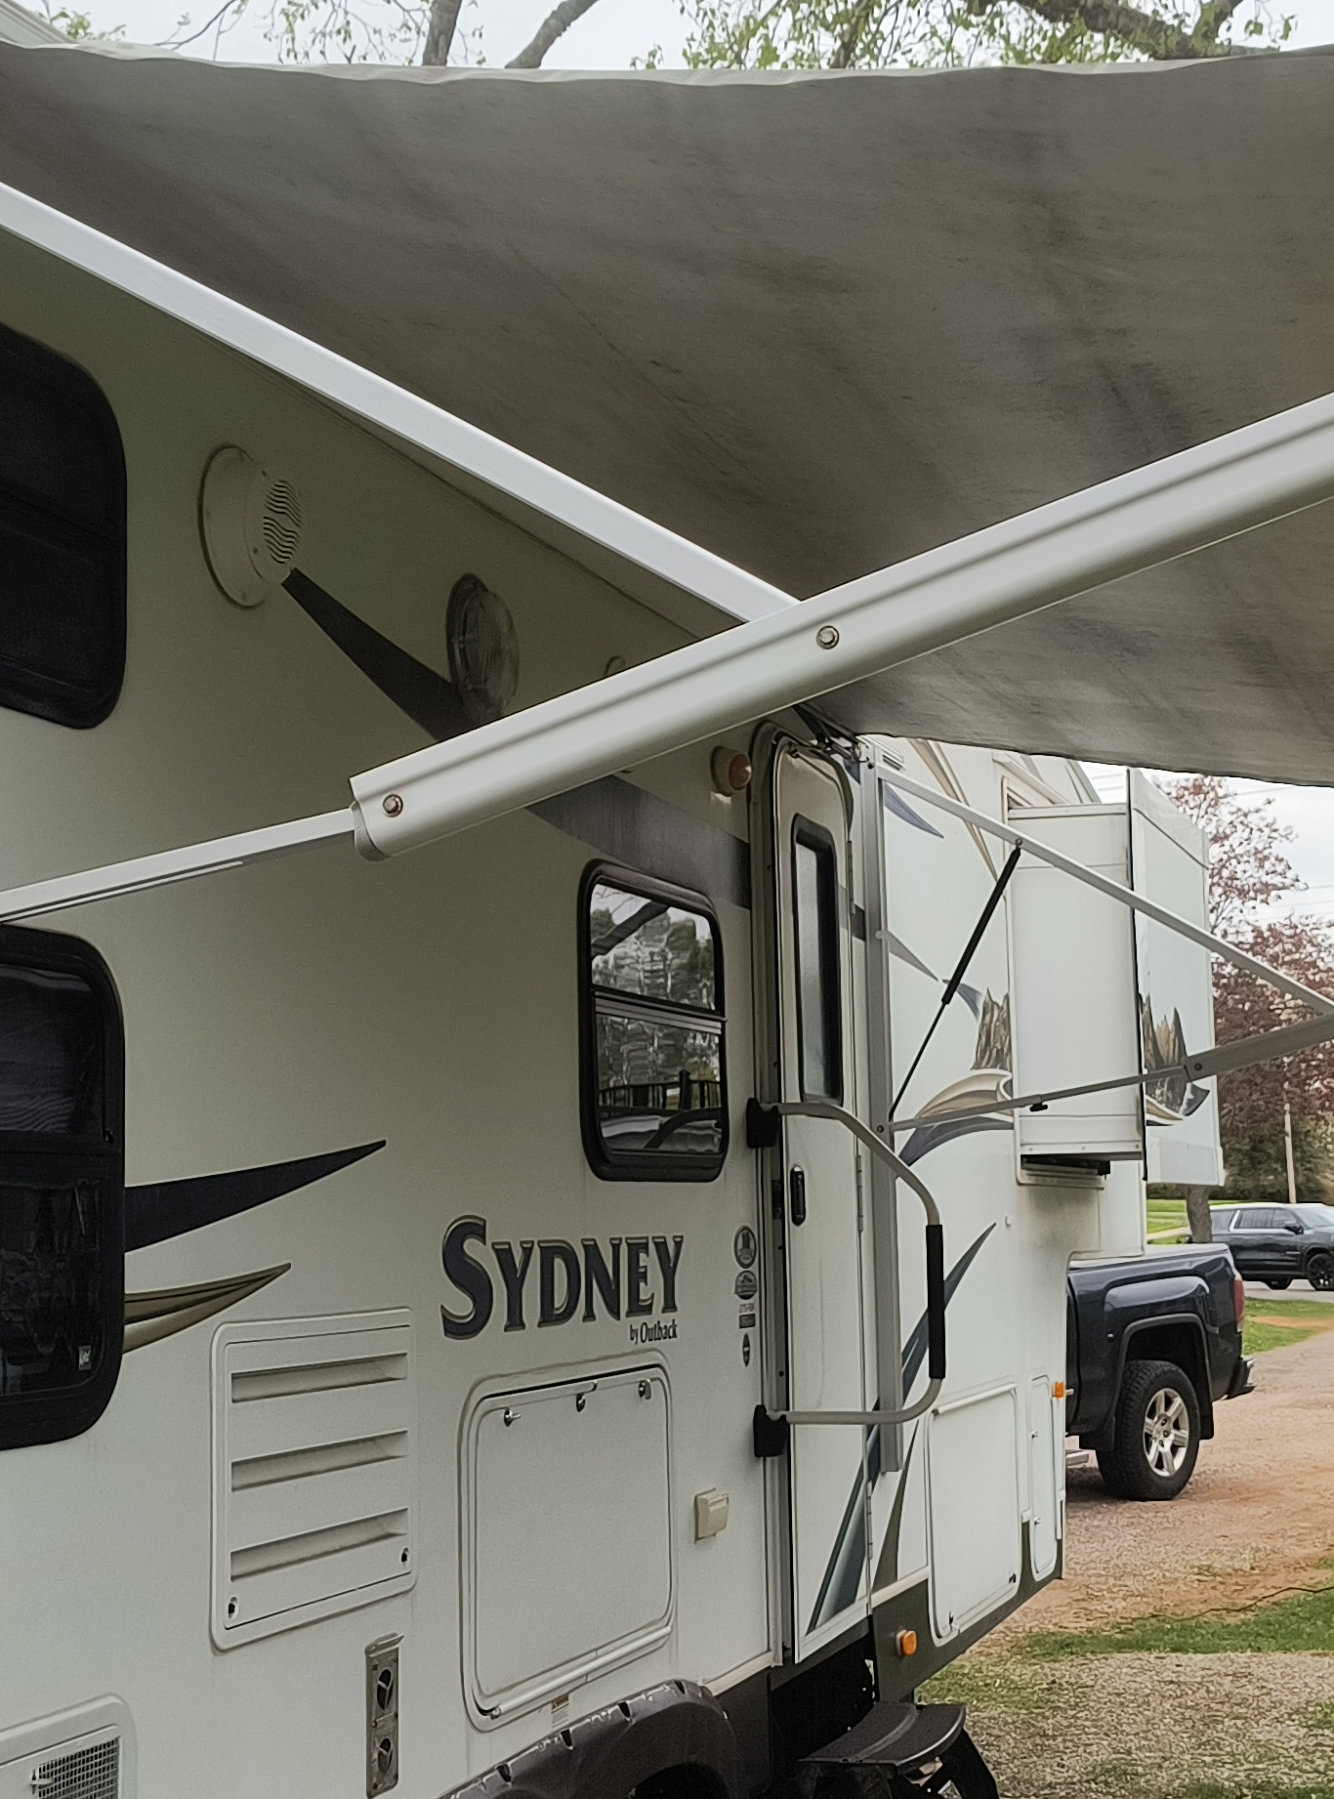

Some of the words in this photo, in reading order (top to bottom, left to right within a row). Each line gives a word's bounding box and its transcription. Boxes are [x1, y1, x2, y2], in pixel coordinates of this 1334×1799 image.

[440, 1214, 684, 1340] SYDNEY
[629, 1323, 638, 1345] by
[640, 1318, 678, 1343] Outback
